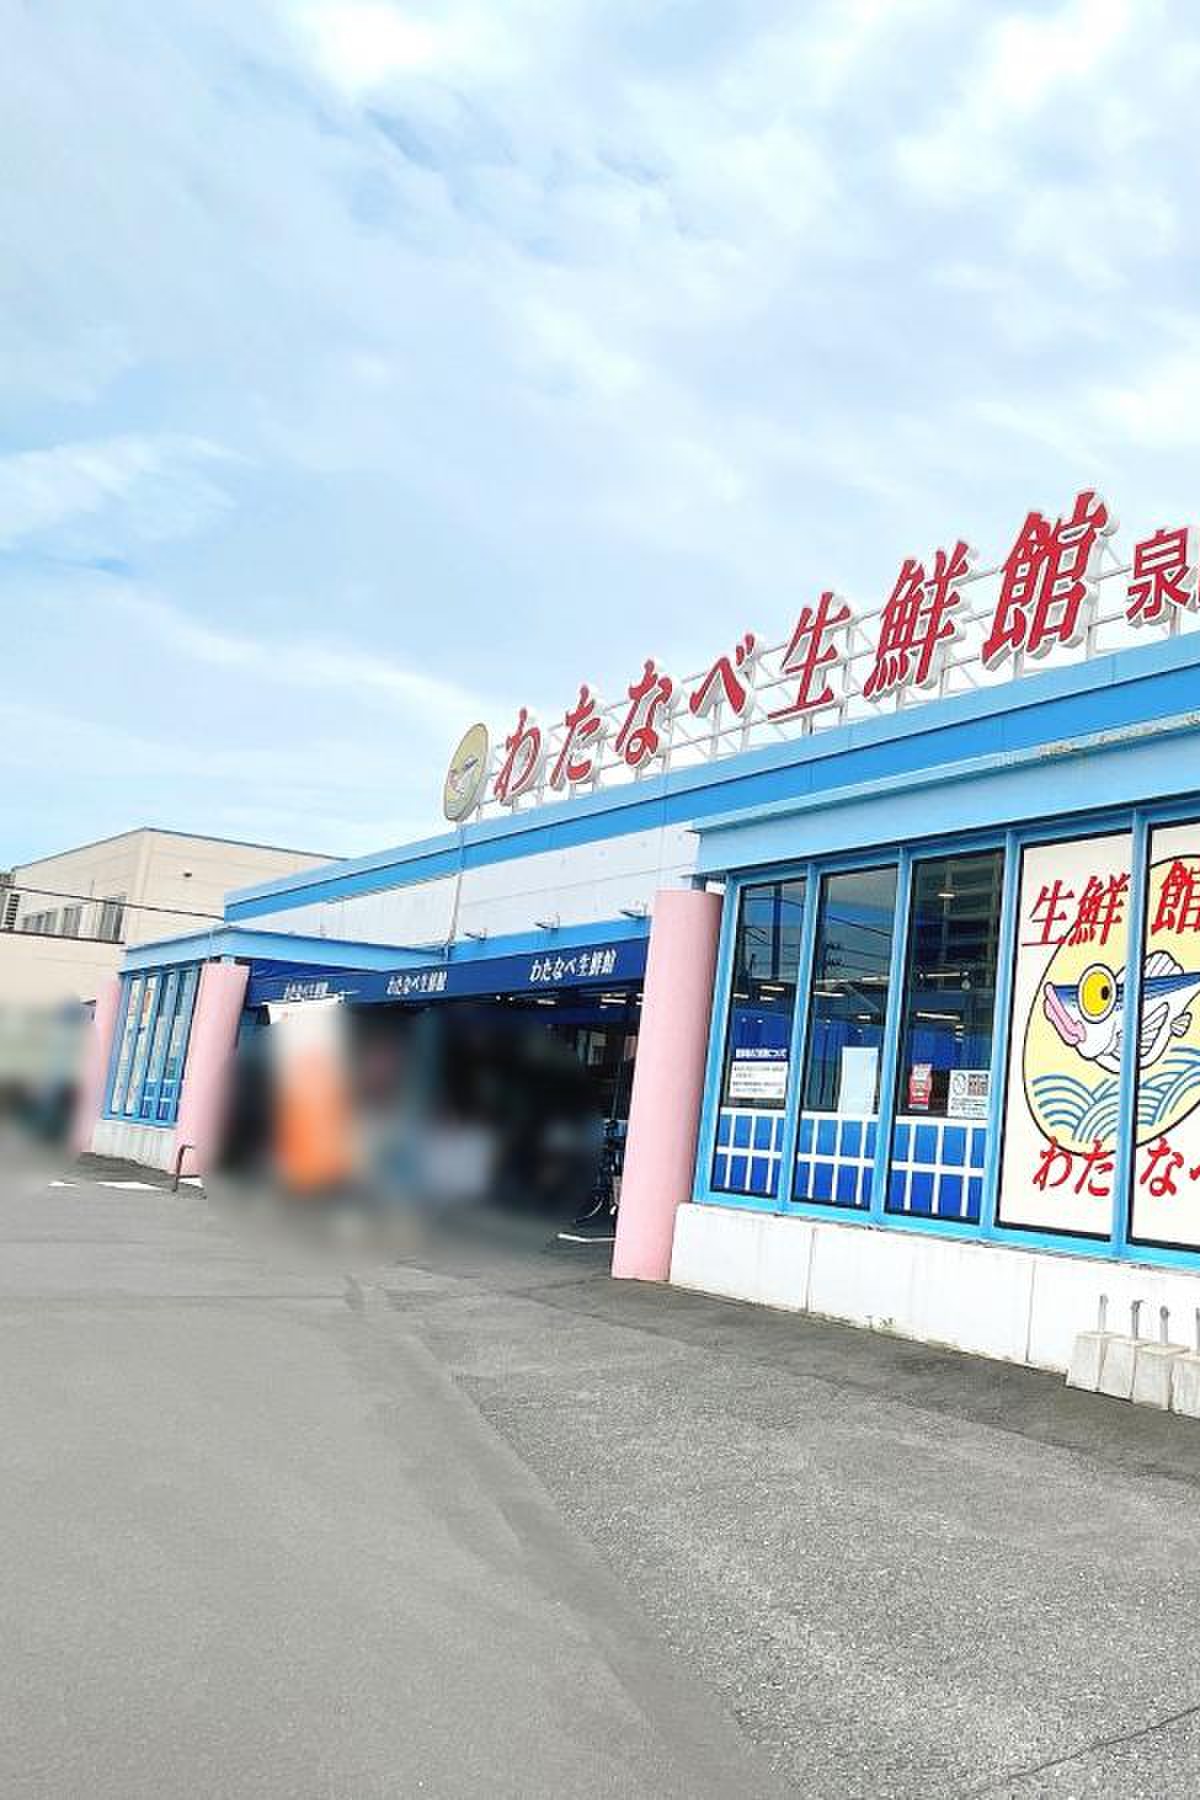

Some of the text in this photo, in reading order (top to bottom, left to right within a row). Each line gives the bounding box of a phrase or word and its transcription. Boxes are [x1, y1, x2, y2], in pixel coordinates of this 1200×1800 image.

[491, 490, 1110, 803] わたなべ生鮮館
[529, 949, 617, 983] わたなべ生鮮館
